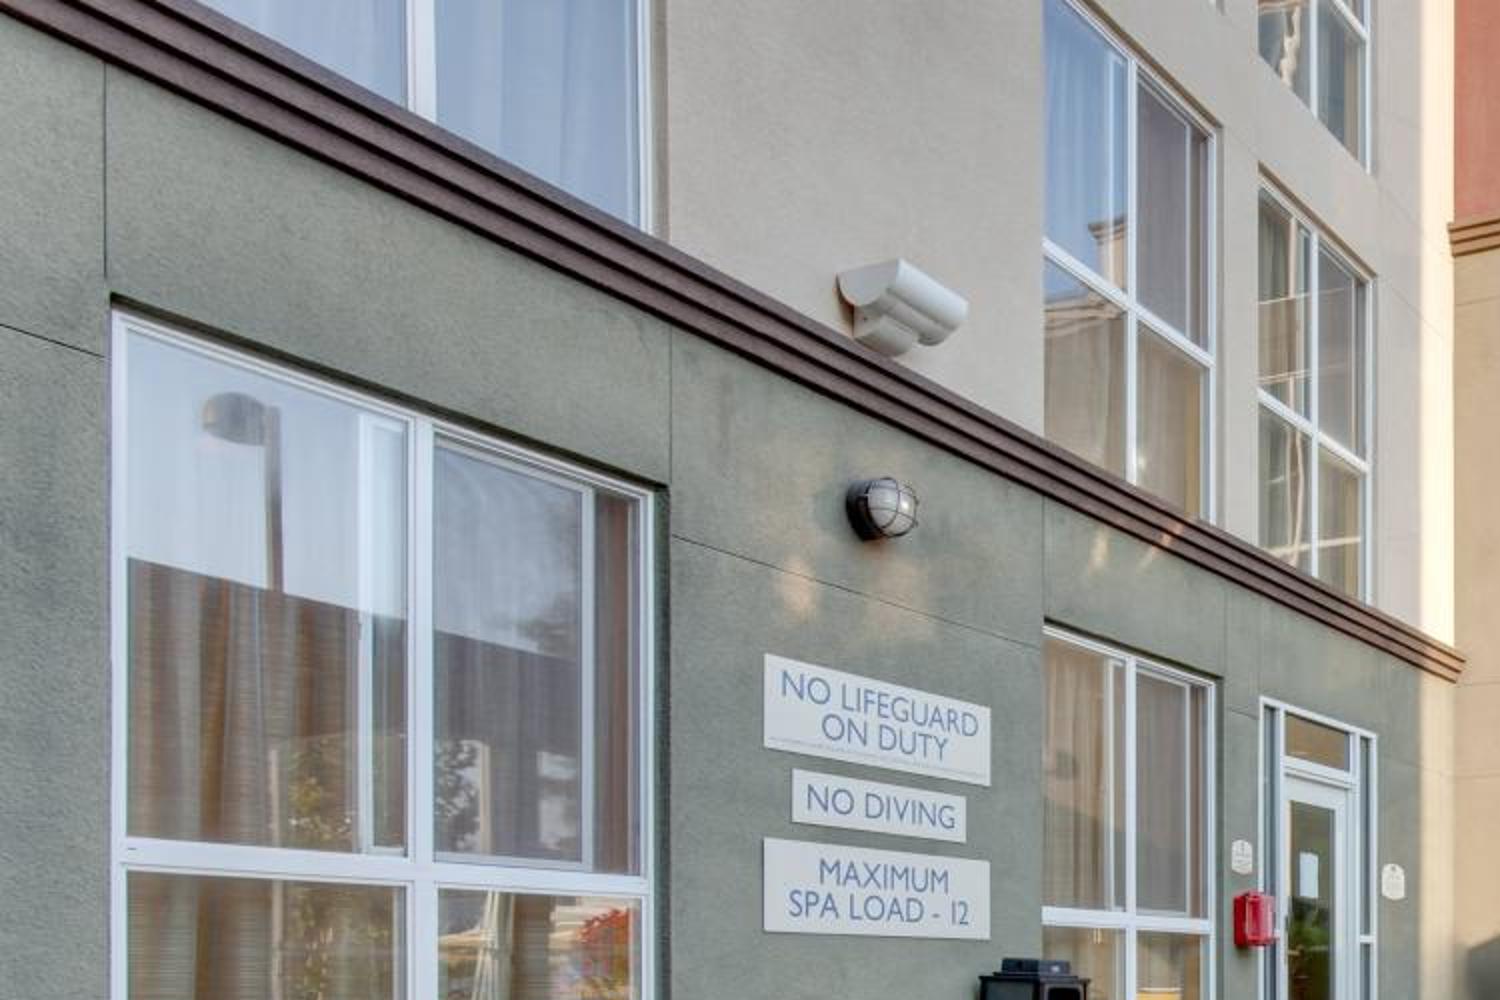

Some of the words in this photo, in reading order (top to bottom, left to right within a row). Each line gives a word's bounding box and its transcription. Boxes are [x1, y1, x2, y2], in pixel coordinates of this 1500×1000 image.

[782, 671, 830, 705] NO
[842, 685, 978, 736] LIFEGUARD
[821, 713, 868, 747] ON
[878, 724, 949, 761] DUTY
[806, 783, 854, 815] NO
[865, 793, 956, 829] DIVING
[820, 860, 948, 892] MAXIMUM
[789, 890, 839, 918] SPA
[850, 895, 924, 922] LOAD
[952, 901, 969, 925] 12
